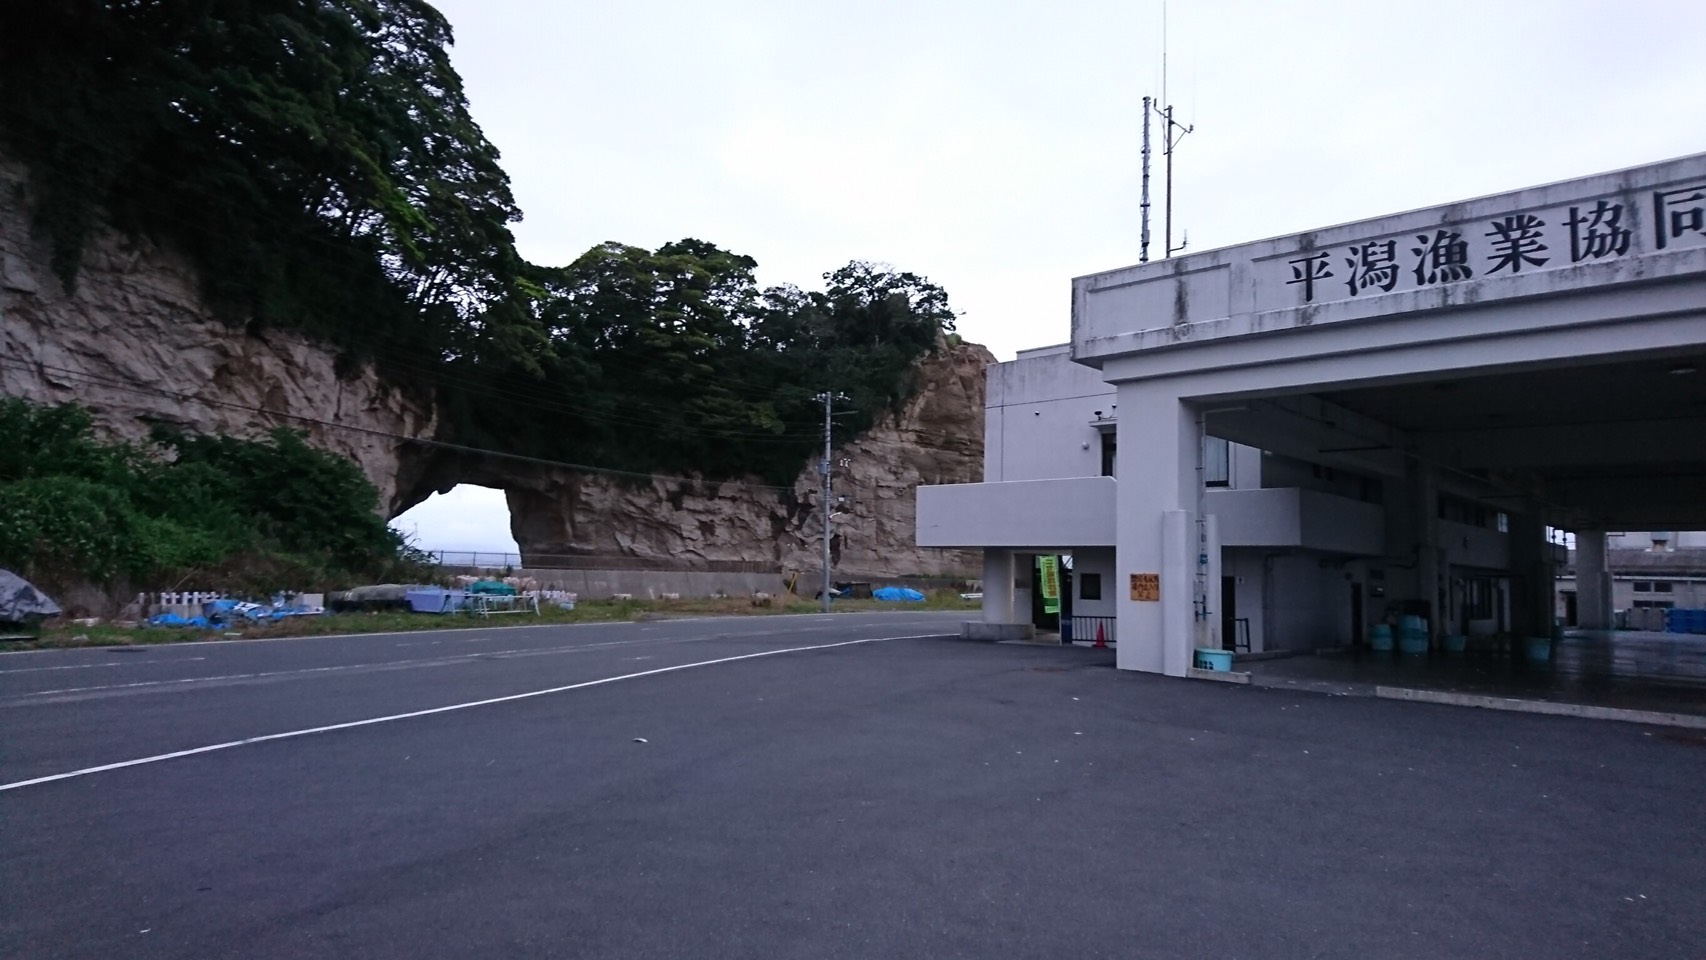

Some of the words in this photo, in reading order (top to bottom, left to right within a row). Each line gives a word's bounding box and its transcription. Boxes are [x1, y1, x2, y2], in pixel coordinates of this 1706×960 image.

[1286, 186, 1706, 302] 平潟漁業協同
